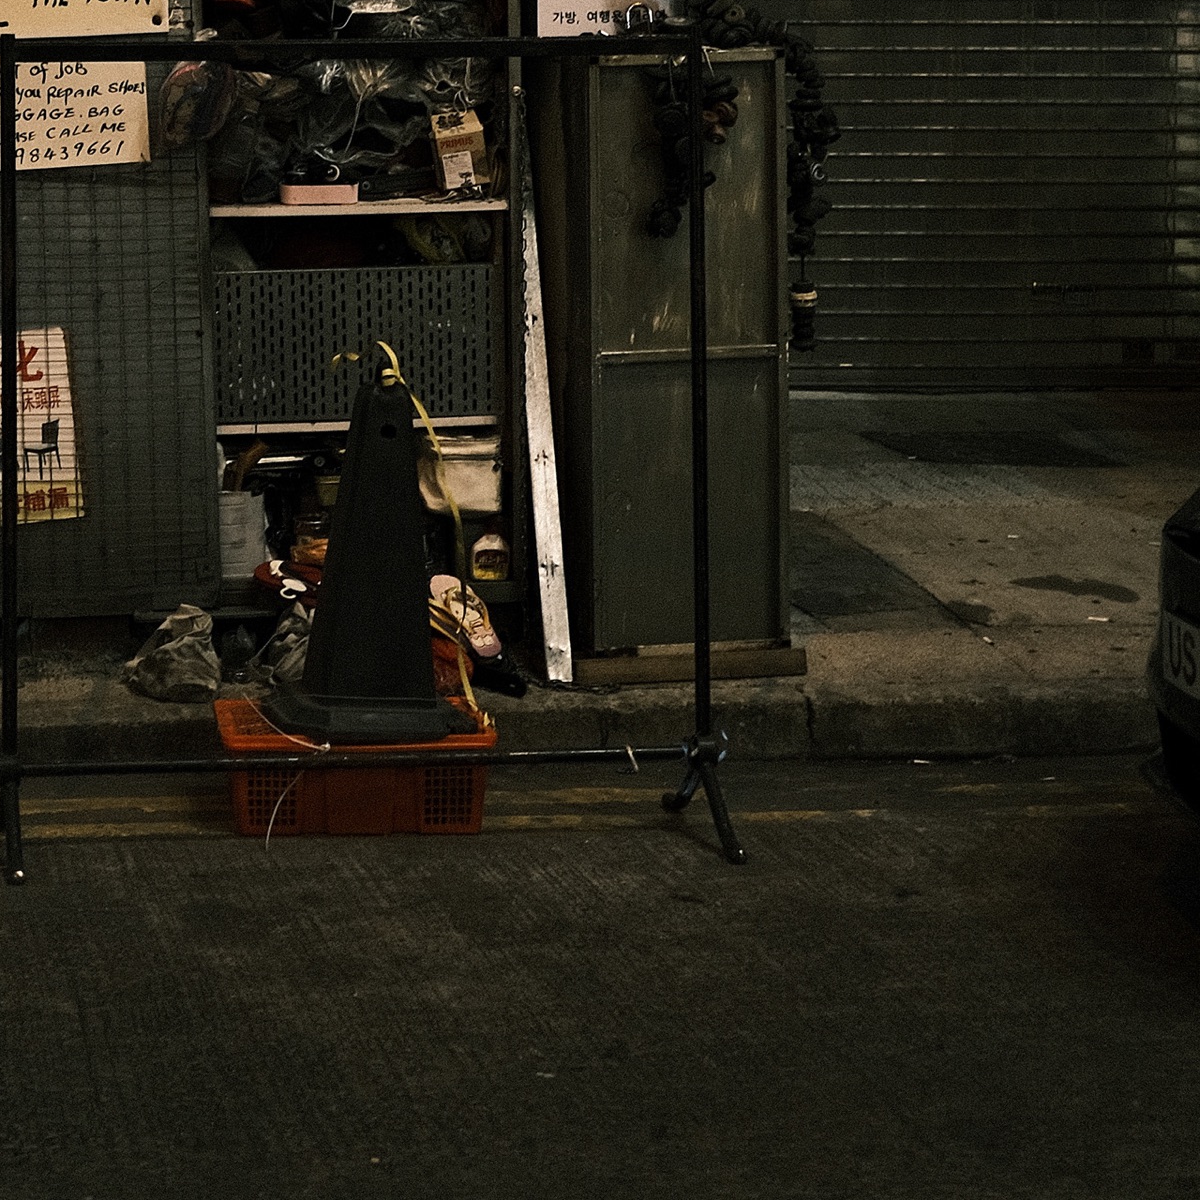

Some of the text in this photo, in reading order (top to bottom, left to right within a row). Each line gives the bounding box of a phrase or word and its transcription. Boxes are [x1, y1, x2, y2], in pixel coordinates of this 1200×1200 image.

[88, 104, 124, 118] BAG
[46, 124, 93, 139] CALL
[99, 122, 126, 133] ME
[440, 135, 474, 150] PRIMUS
